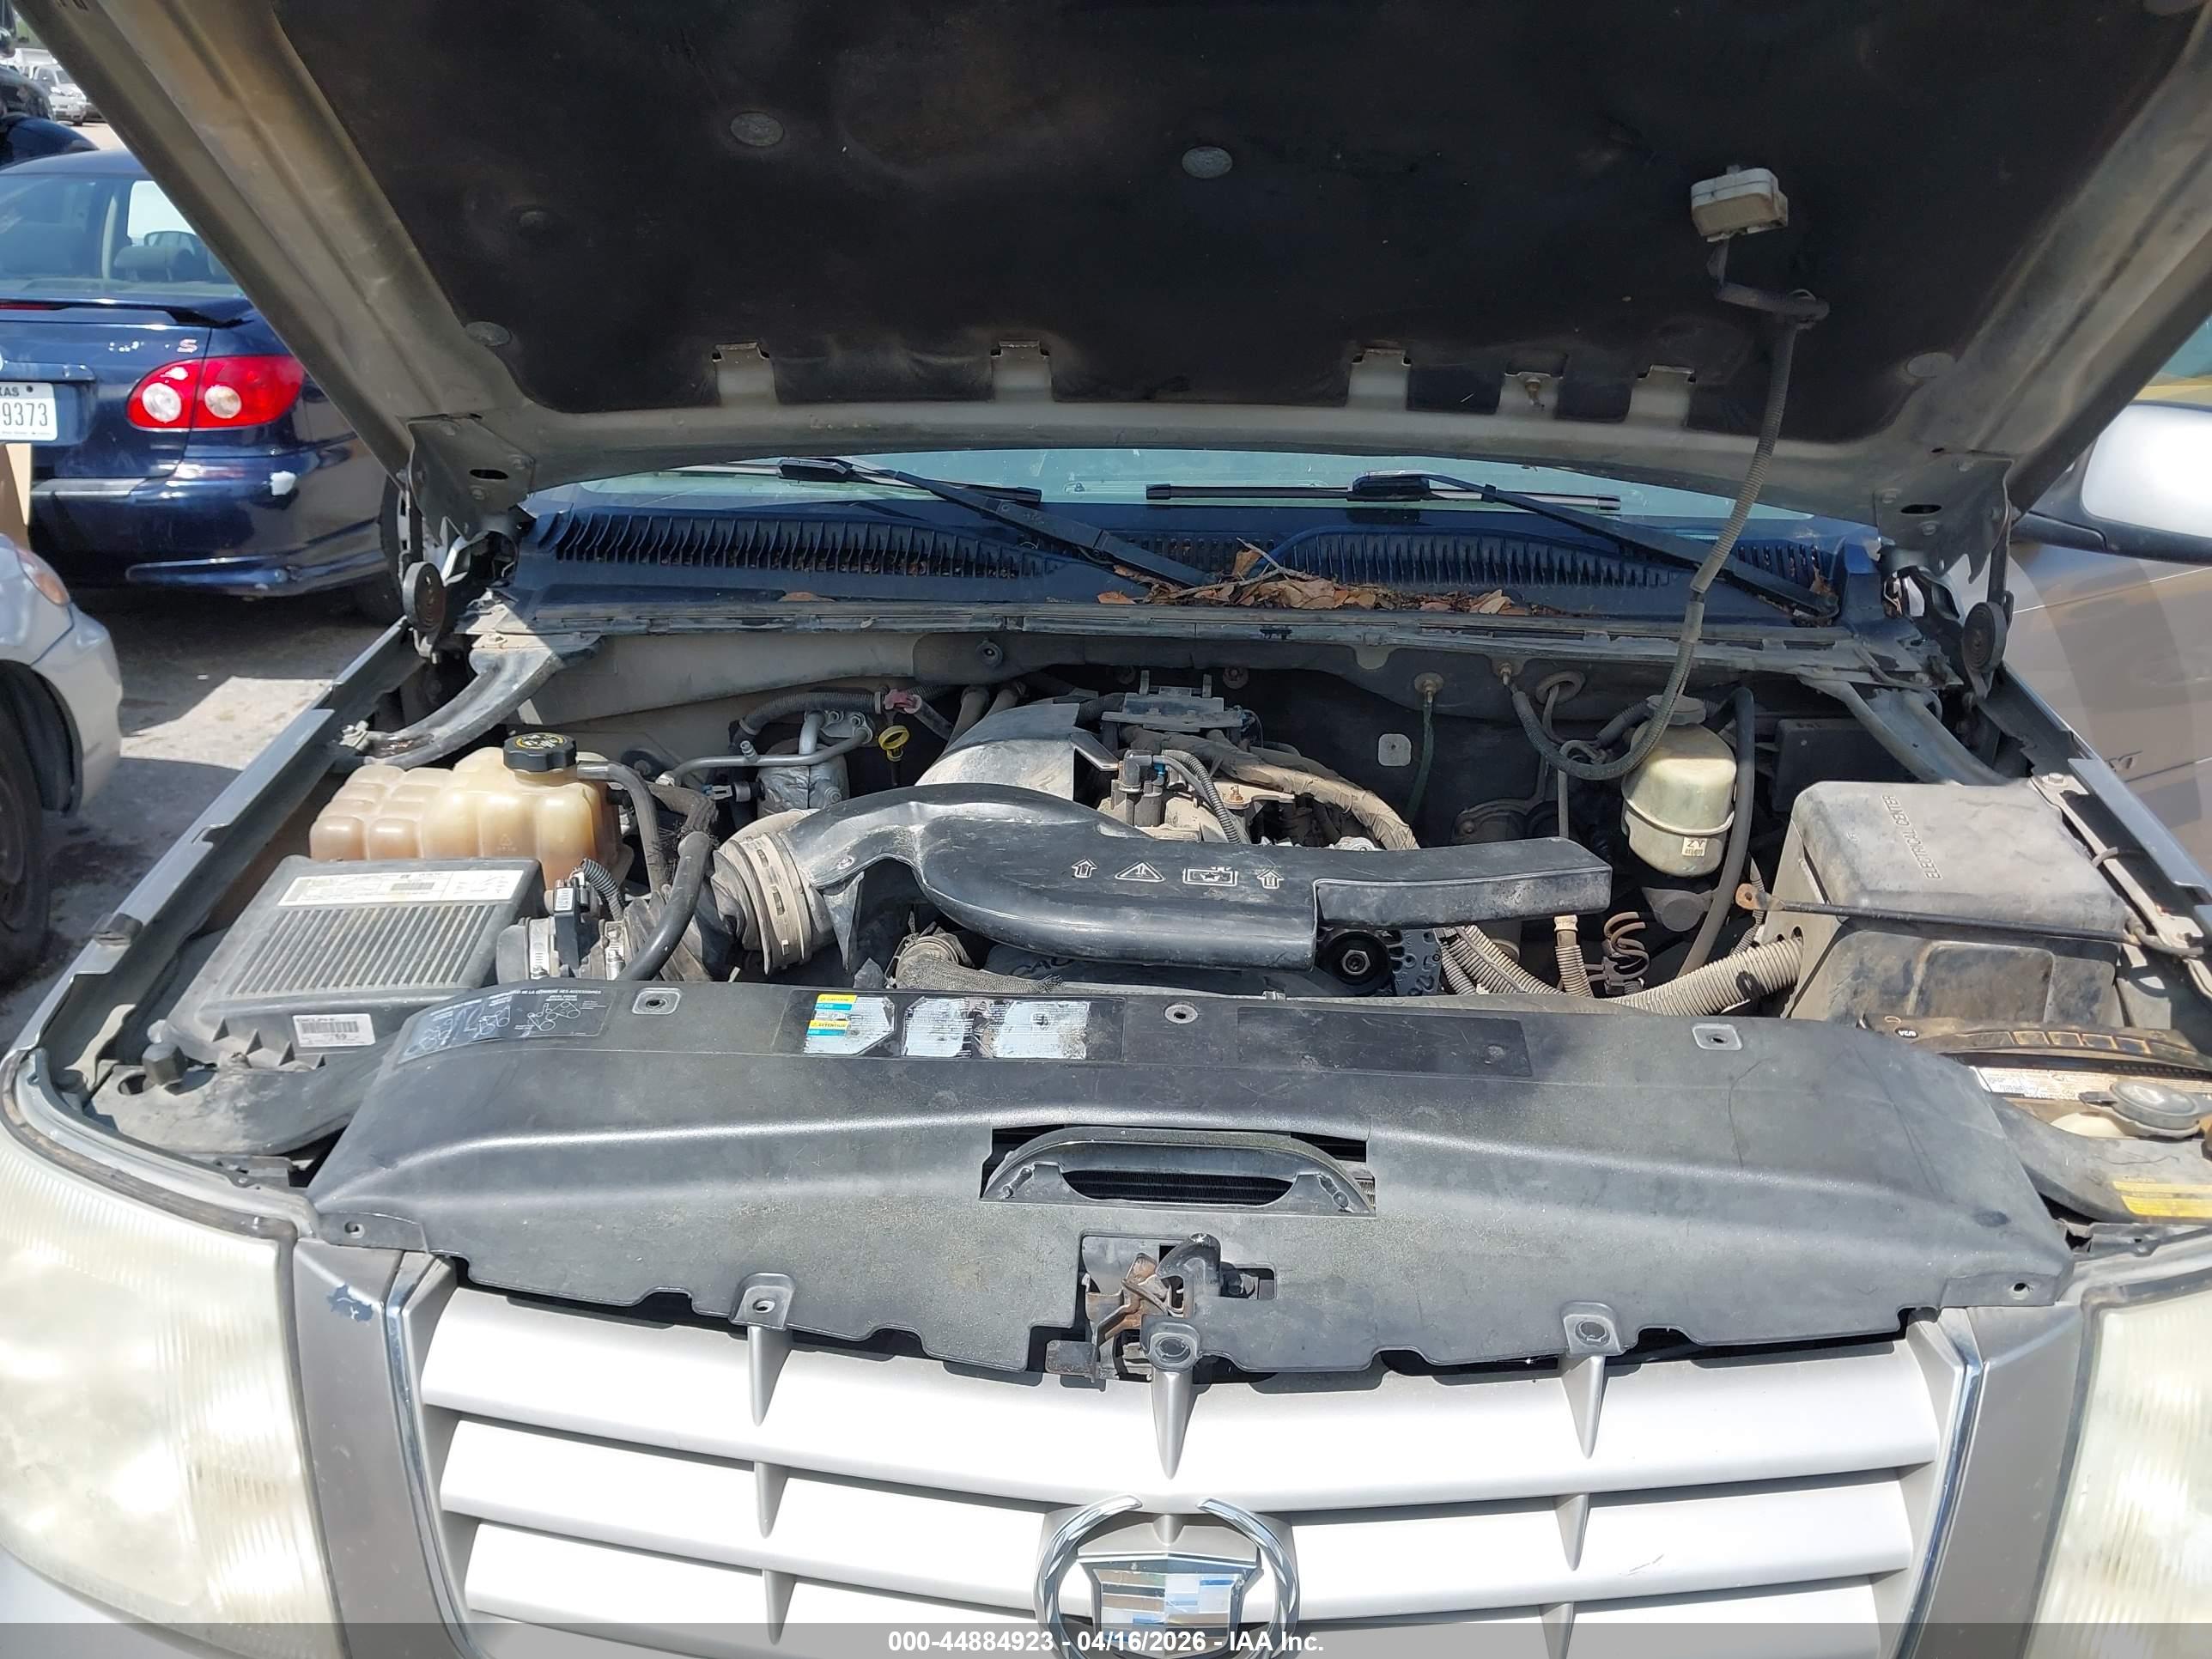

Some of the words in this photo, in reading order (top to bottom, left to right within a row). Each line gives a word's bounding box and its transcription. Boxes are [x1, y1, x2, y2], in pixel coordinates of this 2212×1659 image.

[176, 338, 198, 354] S
[2, 402, 48, 427] 9373
[1901, 826, 1942, 879] ELECTRICAL
